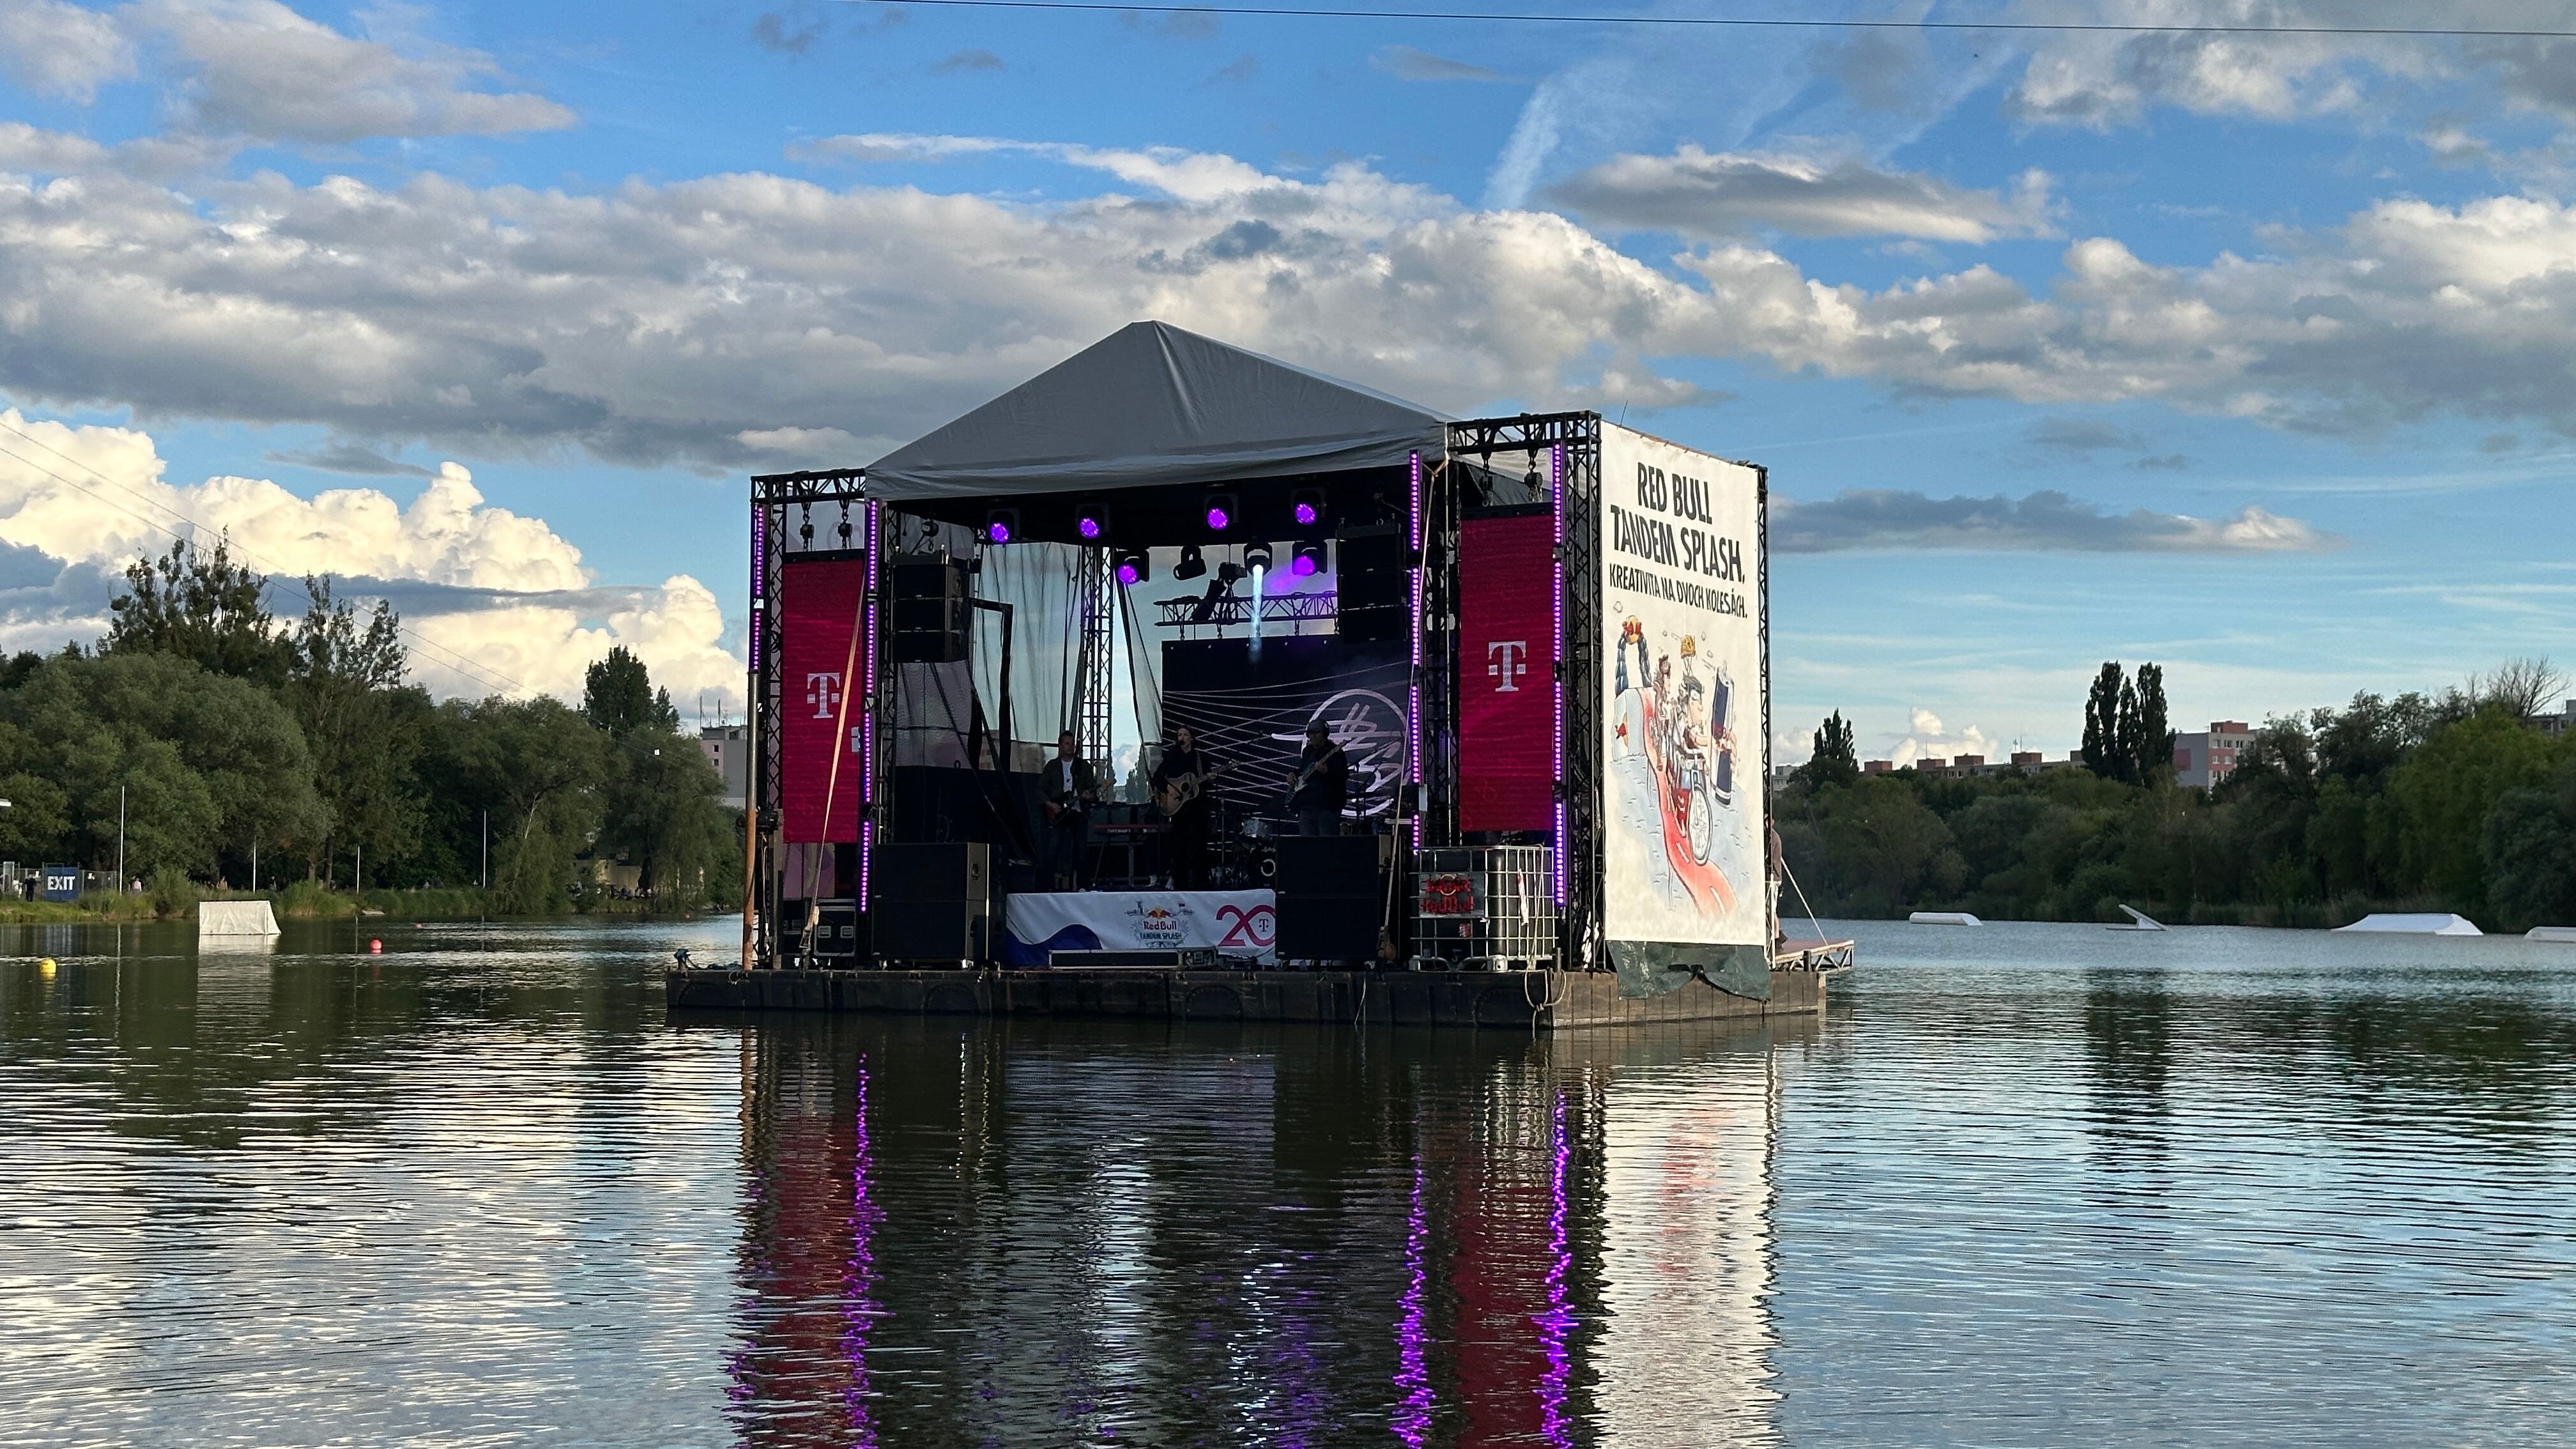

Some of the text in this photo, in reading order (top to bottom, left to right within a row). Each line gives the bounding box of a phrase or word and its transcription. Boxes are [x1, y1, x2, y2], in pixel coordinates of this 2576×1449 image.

[1637, 462, 1713, 525] RED BULL
[1610, 504, 1678, 567] TANDEM
[1609, 563, 1748, 618] KREATIVITA NA DVOCH KOLESÁCH.
[47, 875, 75, 891] EXIT
